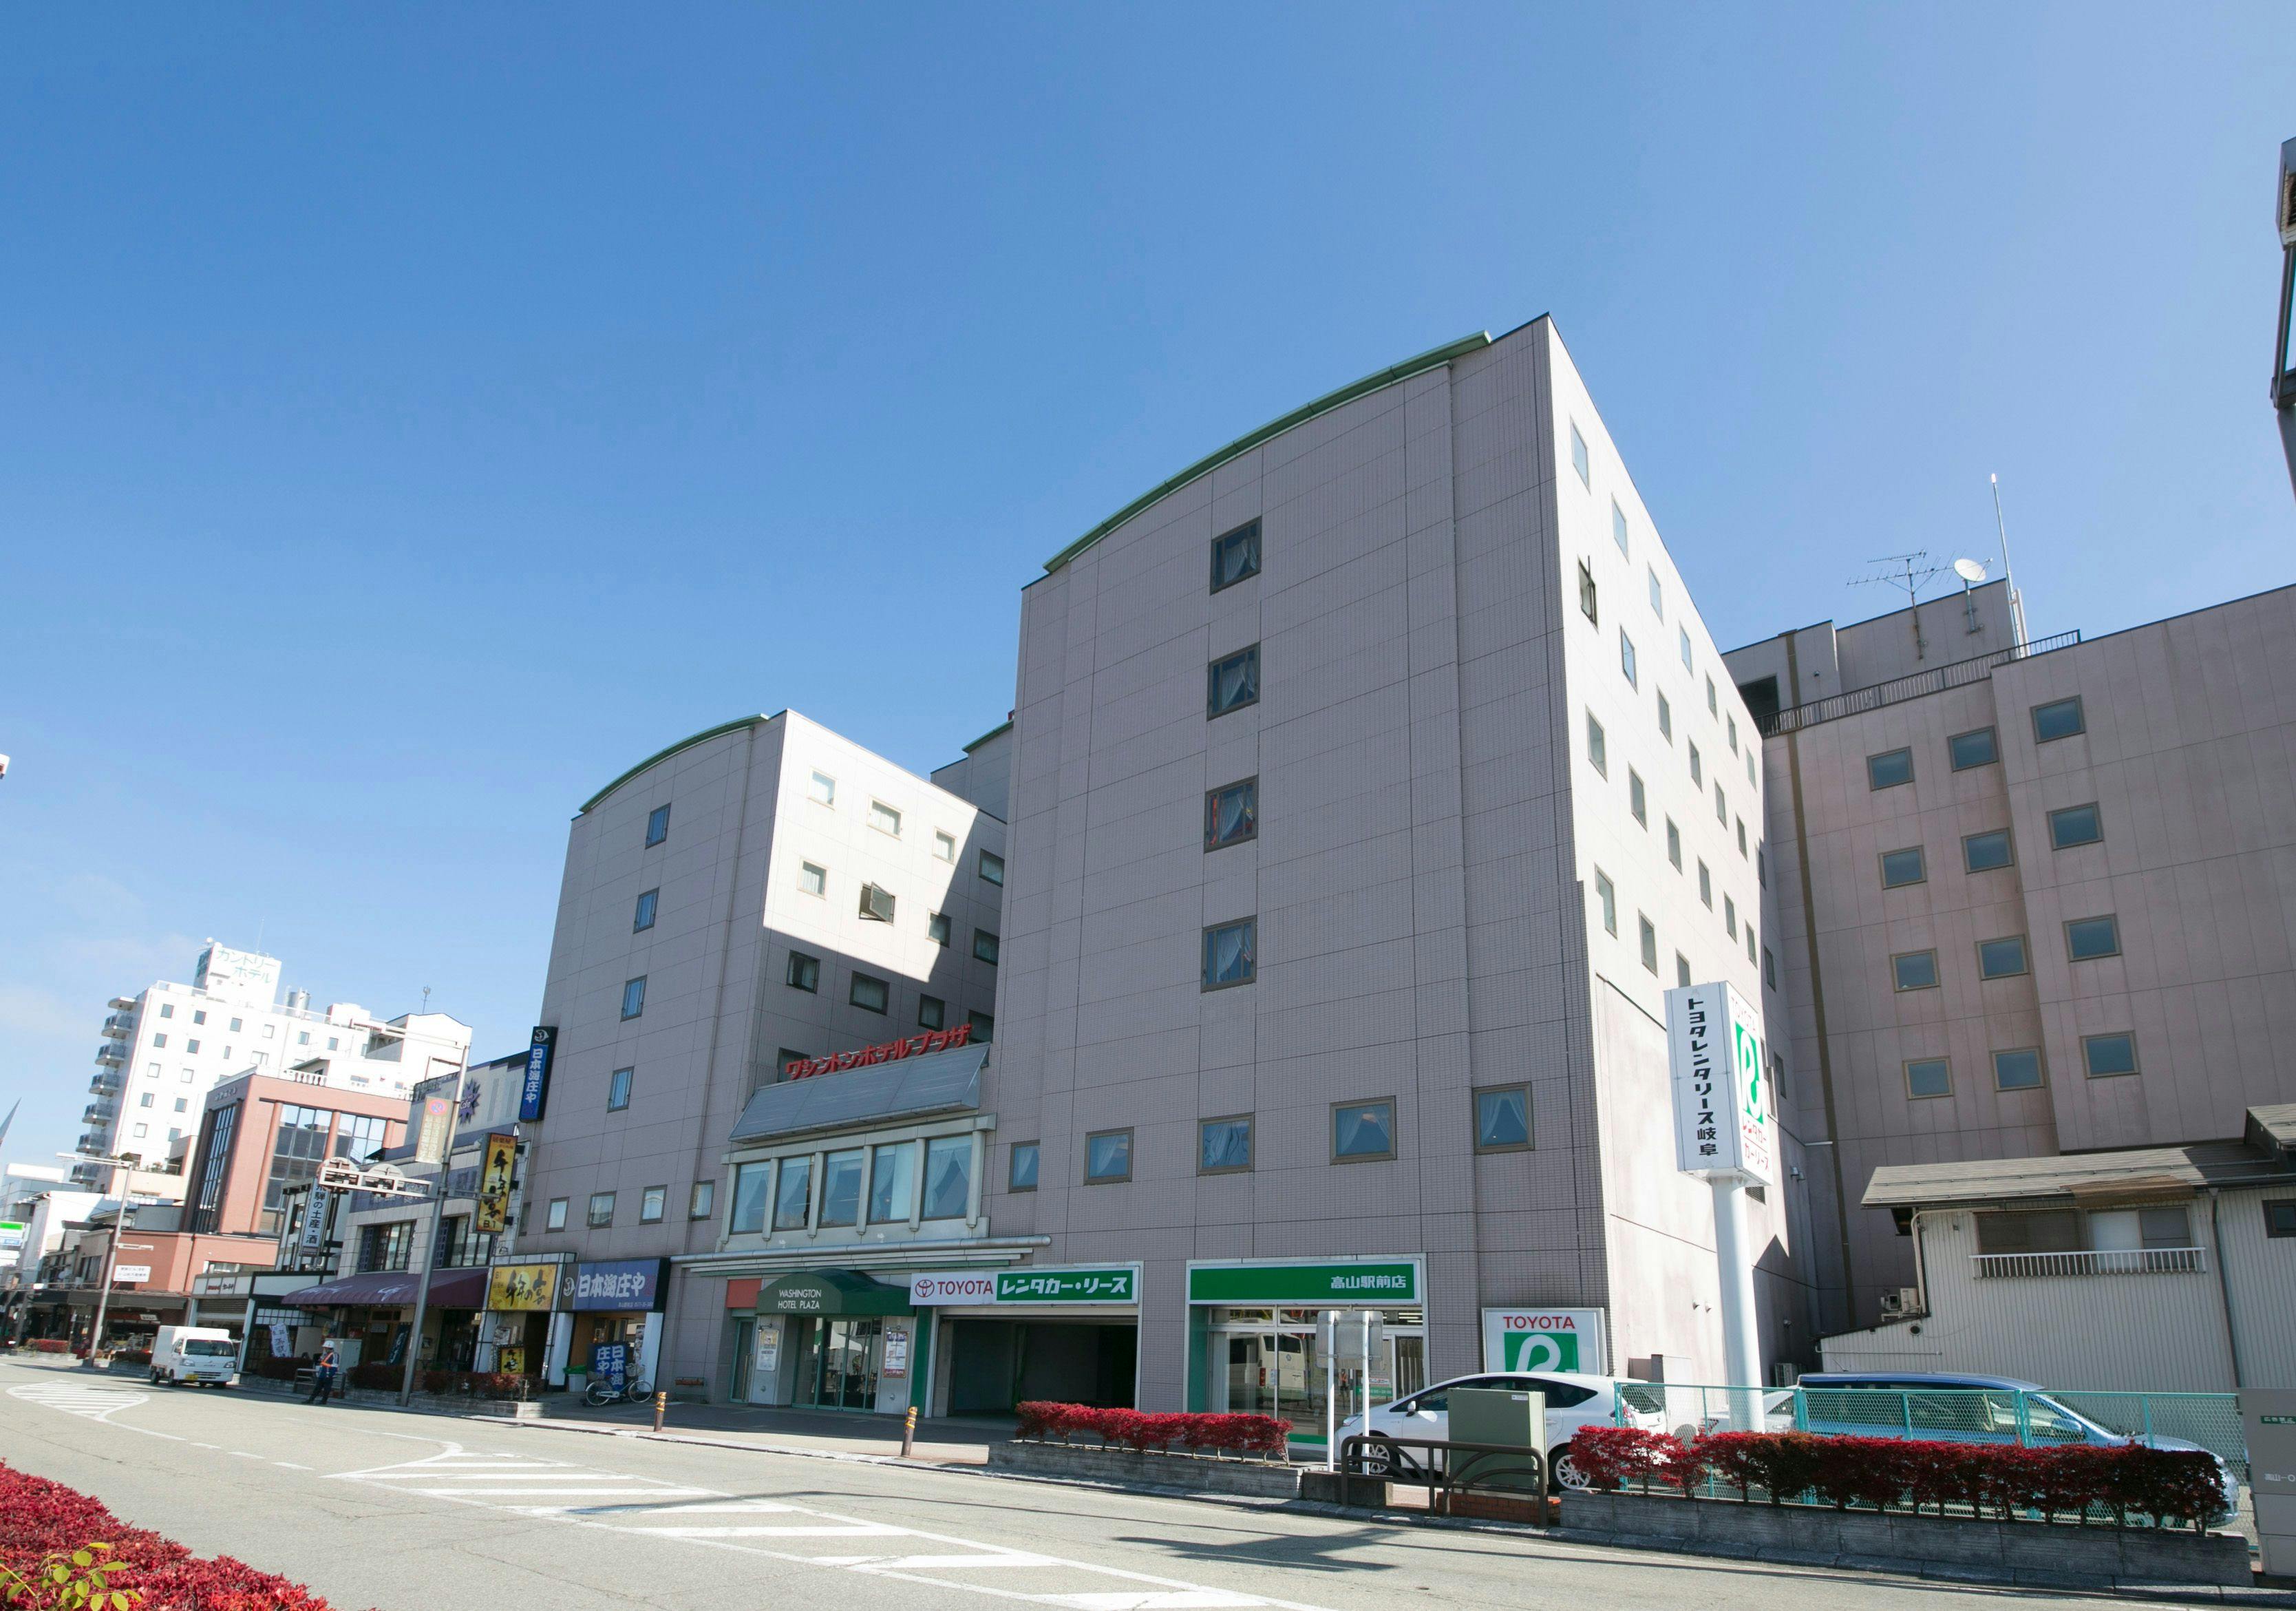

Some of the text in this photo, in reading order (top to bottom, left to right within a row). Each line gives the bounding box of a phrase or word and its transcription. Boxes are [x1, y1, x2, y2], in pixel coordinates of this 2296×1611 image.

[233, 967, 272, 984] ホテル
[785, 1023, 972, 1081] ワシントンホテルプラザ
[525, 1048, 544, 1103] 日本海庄や
[1688, 998, 1719, 1157] トヨタレンタリース岐阜
[577, 1272, 646, 1298] 日本海庄や
[937, 1280, 993, 1295] TOYOTA
[1330, 1275, 1406, 1289] 高山駅前店
[779, 1289, 822, 1298] WASHINGTON
[778, 1300, 820, 1309] HOTEL PLAZA
[1503, 1316, 1575, 1329] TOYOTA
